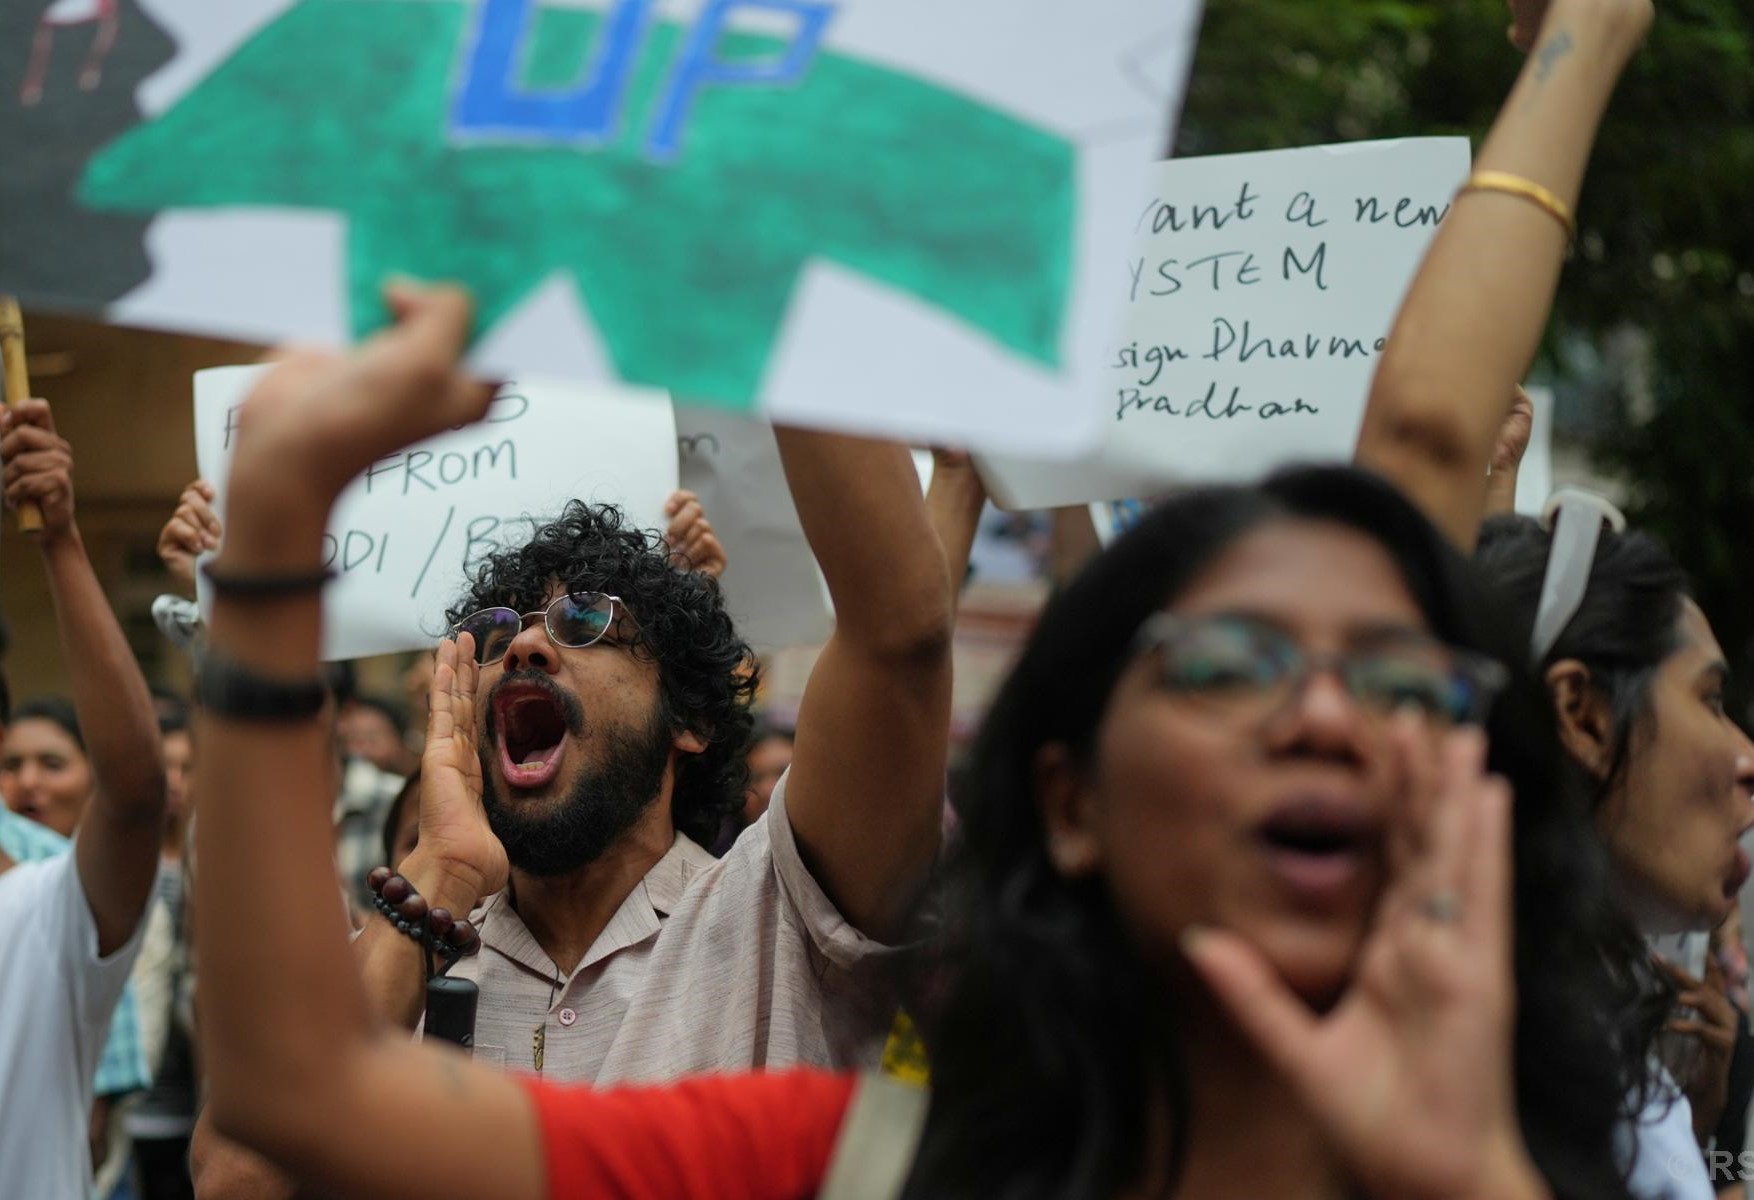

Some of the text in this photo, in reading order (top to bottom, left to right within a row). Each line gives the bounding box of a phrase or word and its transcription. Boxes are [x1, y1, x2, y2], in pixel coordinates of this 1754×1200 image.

[448, 0, 834, 162] UP
[1286, 191, 1327, 228] a
[1128, 241, 1328, 302] YSTEM
[1111, 341, 1189, 386] sign
[1116, 382, 1320, 421] Pradhan
[365, 438, 517, 495] FROM
